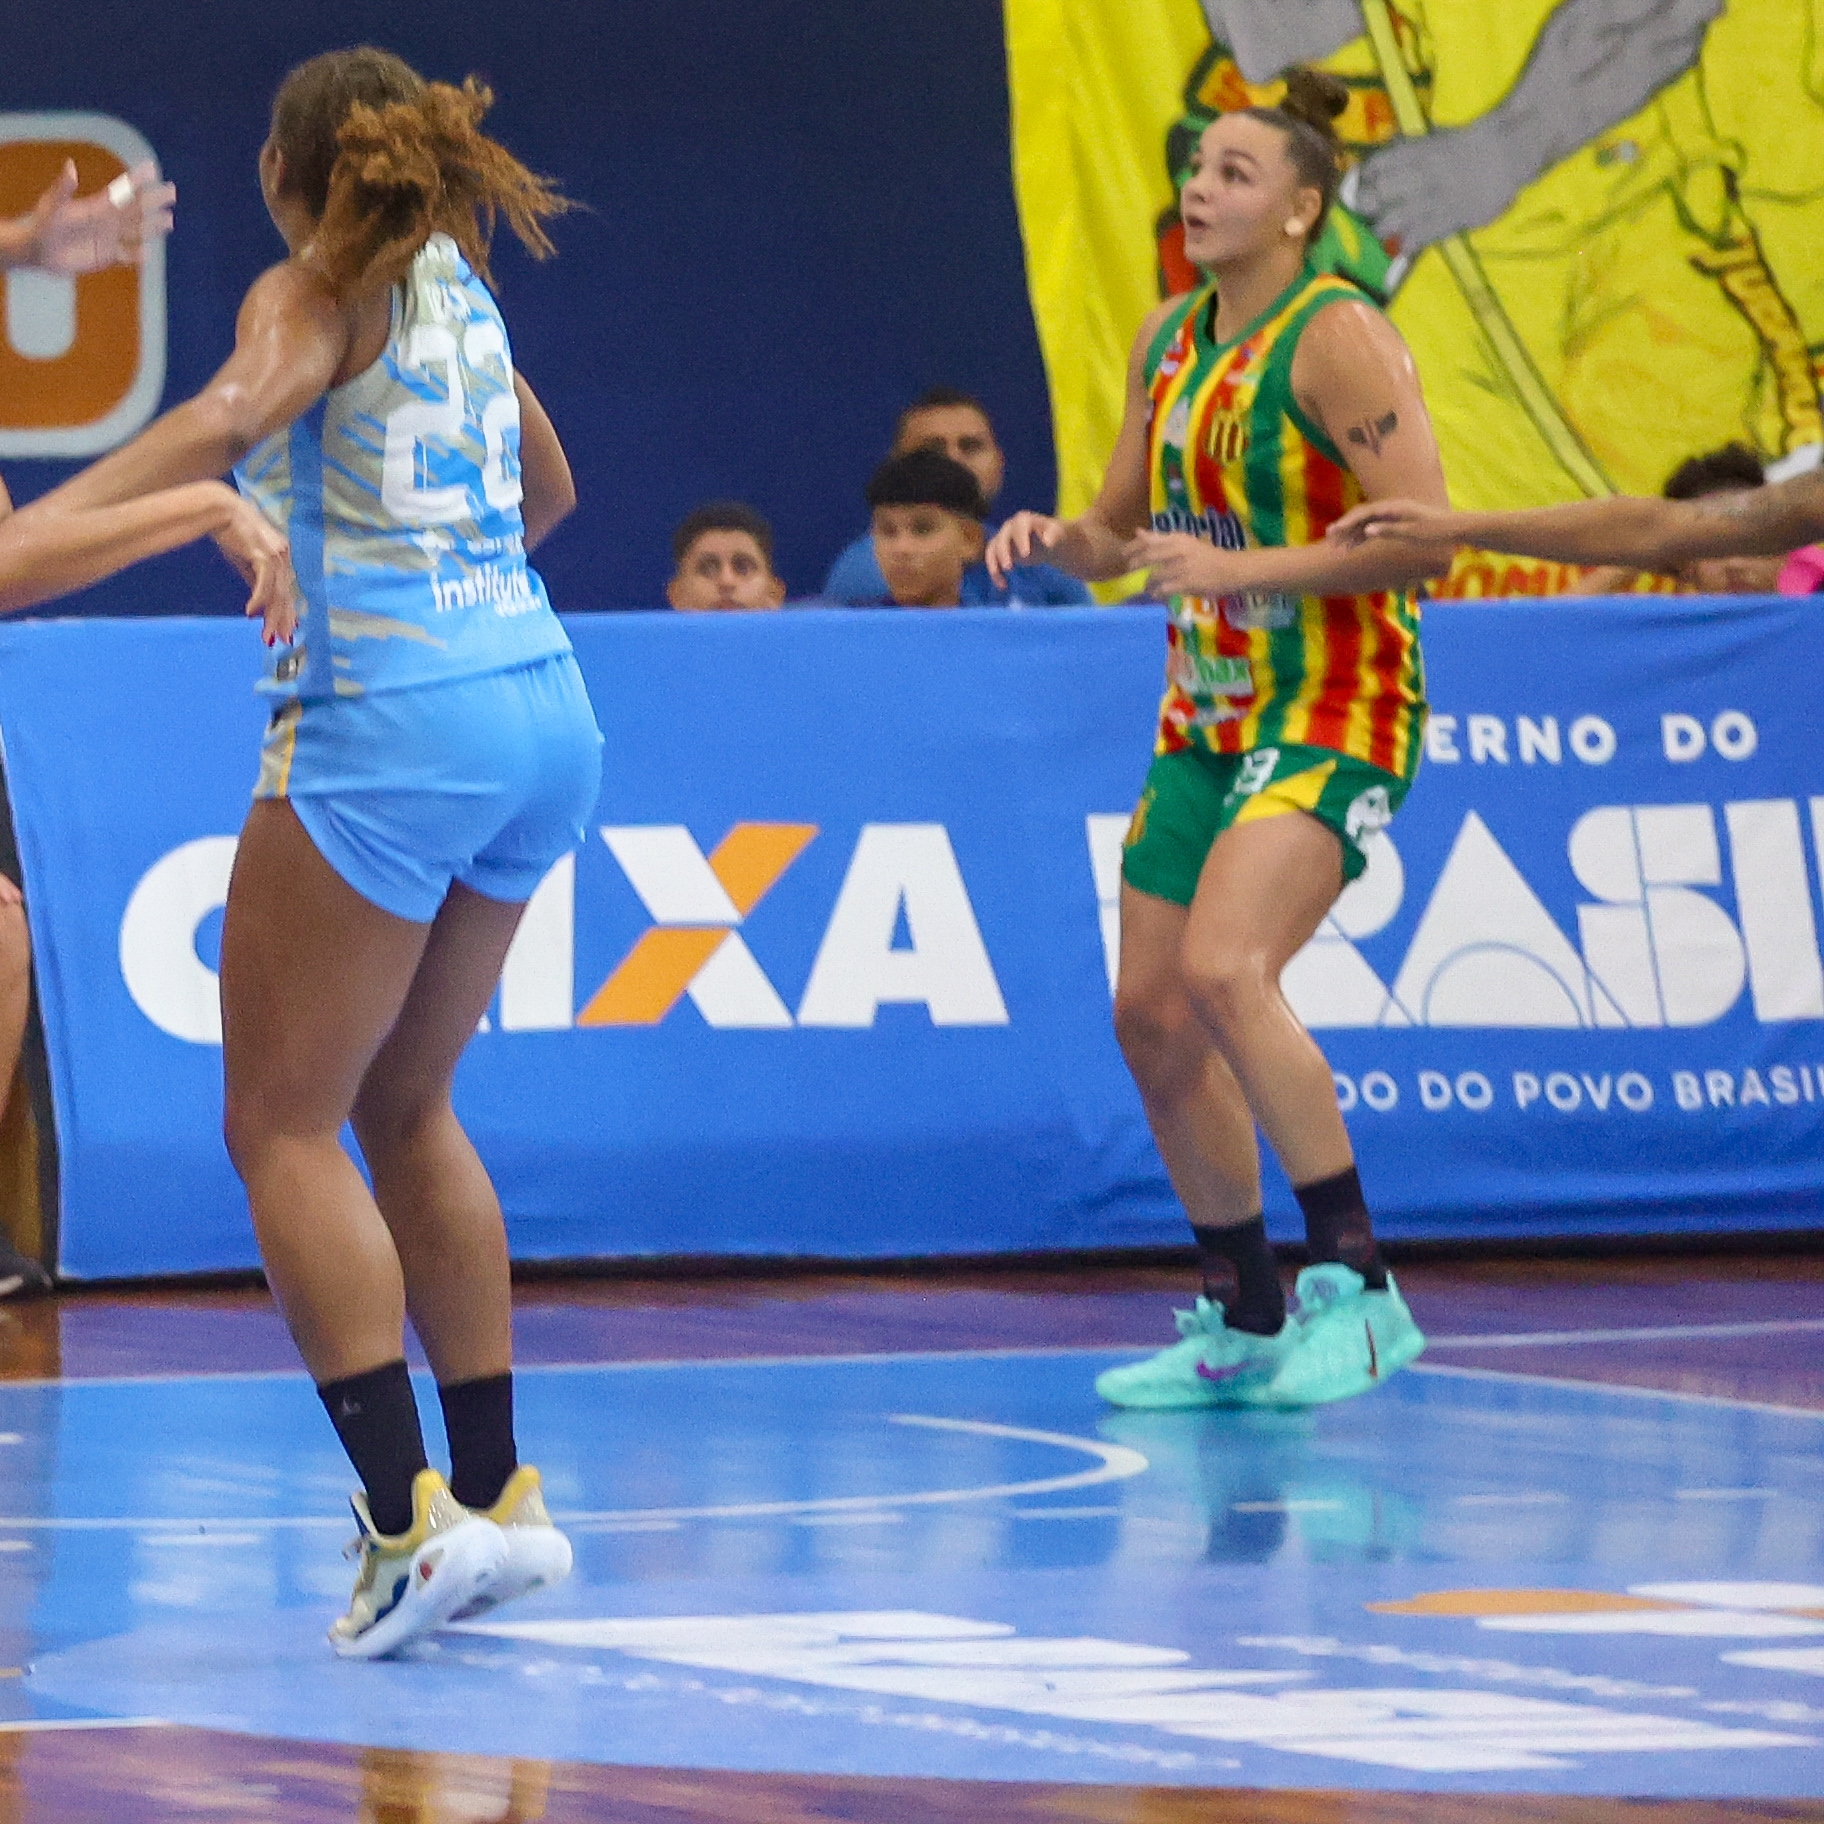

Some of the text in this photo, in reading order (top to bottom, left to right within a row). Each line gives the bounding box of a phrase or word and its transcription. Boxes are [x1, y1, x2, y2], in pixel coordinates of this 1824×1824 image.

[1425, 710, 1758, 766] ERNO DO
[119, 822, 1010, 1044] CIXA
[1418, 1070, 1494, 1111] DO
[1513, 1069, 1653, 1111] POVO
[1673, 1061, 1824, 1112] BRASI
